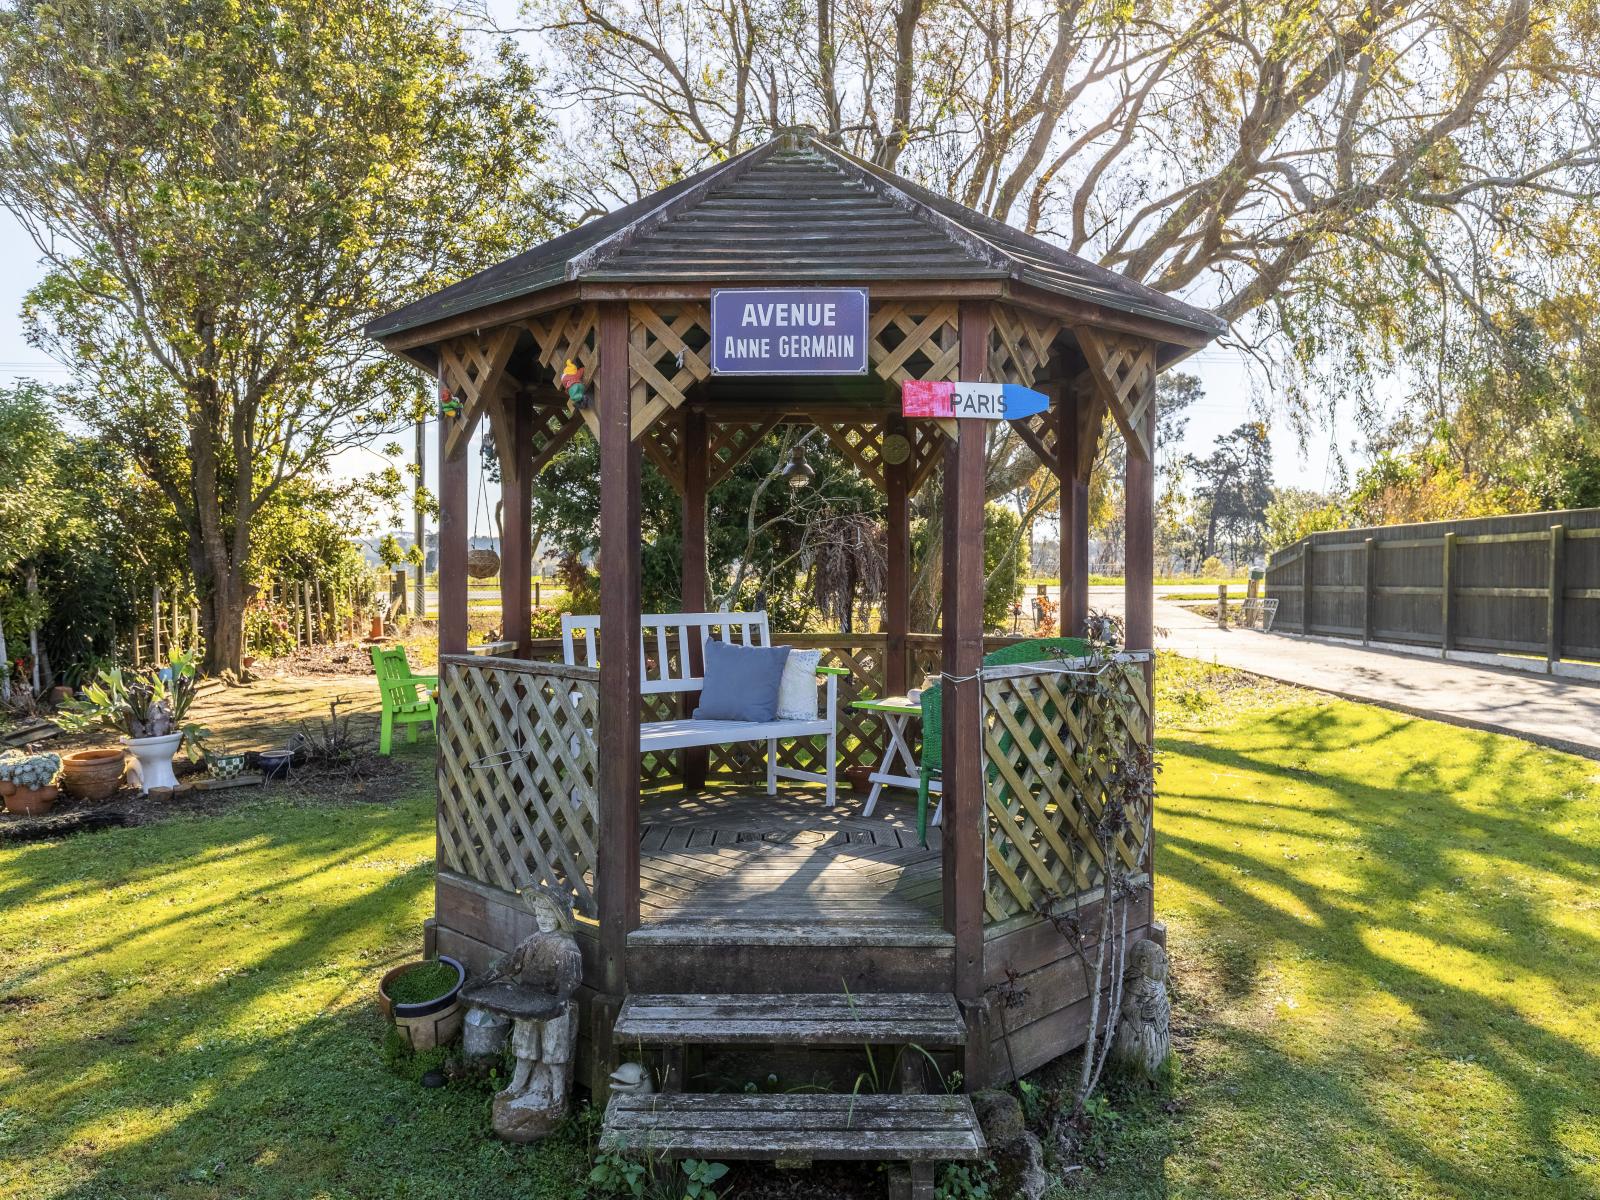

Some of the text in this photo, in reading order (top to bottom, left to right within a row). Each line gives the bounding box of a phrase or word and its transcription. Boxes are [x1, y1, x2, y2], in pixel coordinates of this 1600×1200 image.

[741, 303, 836, 327] AVENUE
[724, 335, 854, 359] ANNE GERMAIN
[950, 393, 1008, 414] PARIS
